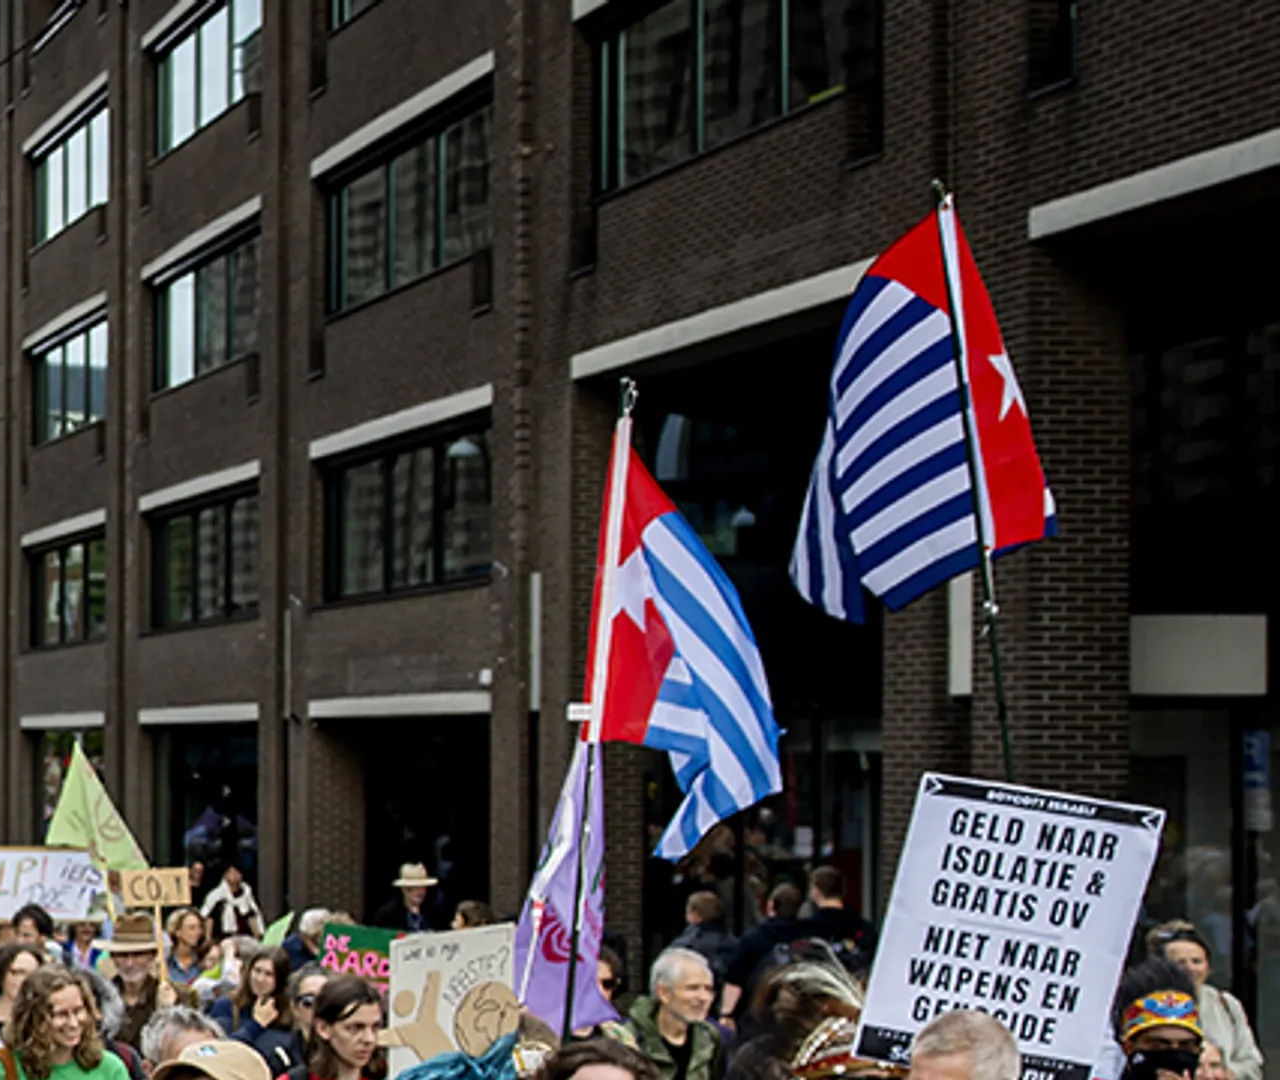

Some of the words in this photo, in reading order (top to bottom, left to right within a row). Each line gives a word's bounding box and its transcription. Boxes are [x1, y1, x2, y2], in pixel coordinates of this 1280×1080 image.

[949, 808, 1024, 846] GELD
[1036, 822, 1119, 861] NAAR
[941, 844, 1076, 892] ISOLATIE
[1085, 870, 1106, 896] &
[931, 878, 1038, 923] GRATIS
[1049, 898, 1090, 929] OV
[324, 934, 351, 953] DE
[923, 927, 989, 961] NIET
[999, 939, 1081, 977] NAAR
[908, 958, 1031, 1004] WAPENS
[1040, 983, 1080, 1012] EN
